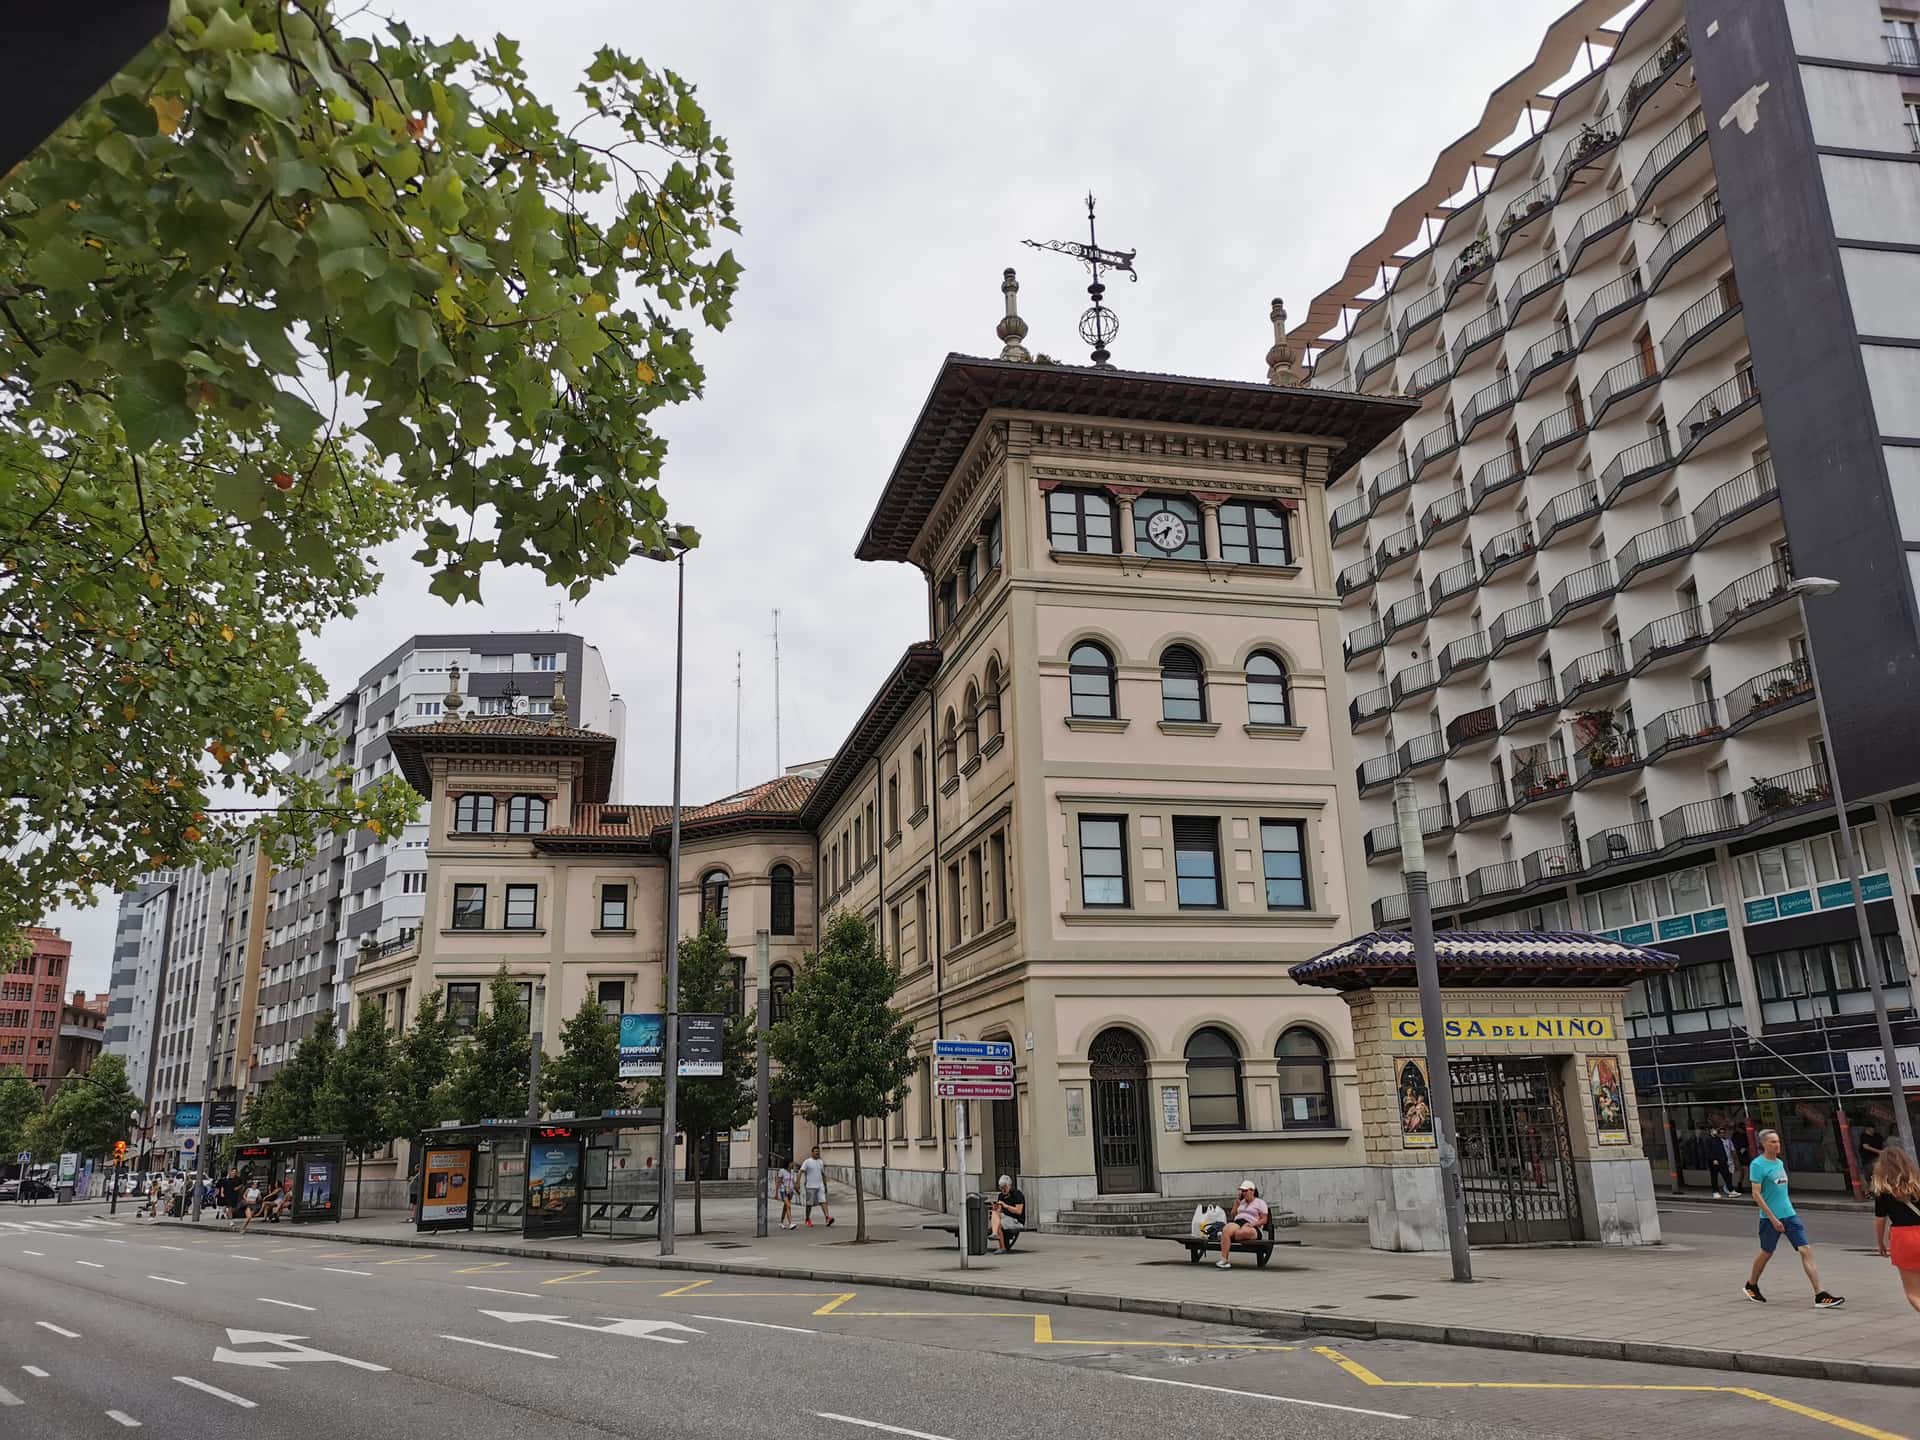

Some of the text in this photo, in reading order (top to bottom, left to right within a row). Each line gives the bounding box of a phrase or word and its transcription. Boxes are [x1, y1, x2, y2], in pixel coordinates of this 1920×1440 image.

[1398, 1018, 1604, 1037] CSA DEL NIÑO
[678, 1058, 722, 1068] CaixaForum
[1854, 1064, 1881, 1081] HOTEL
